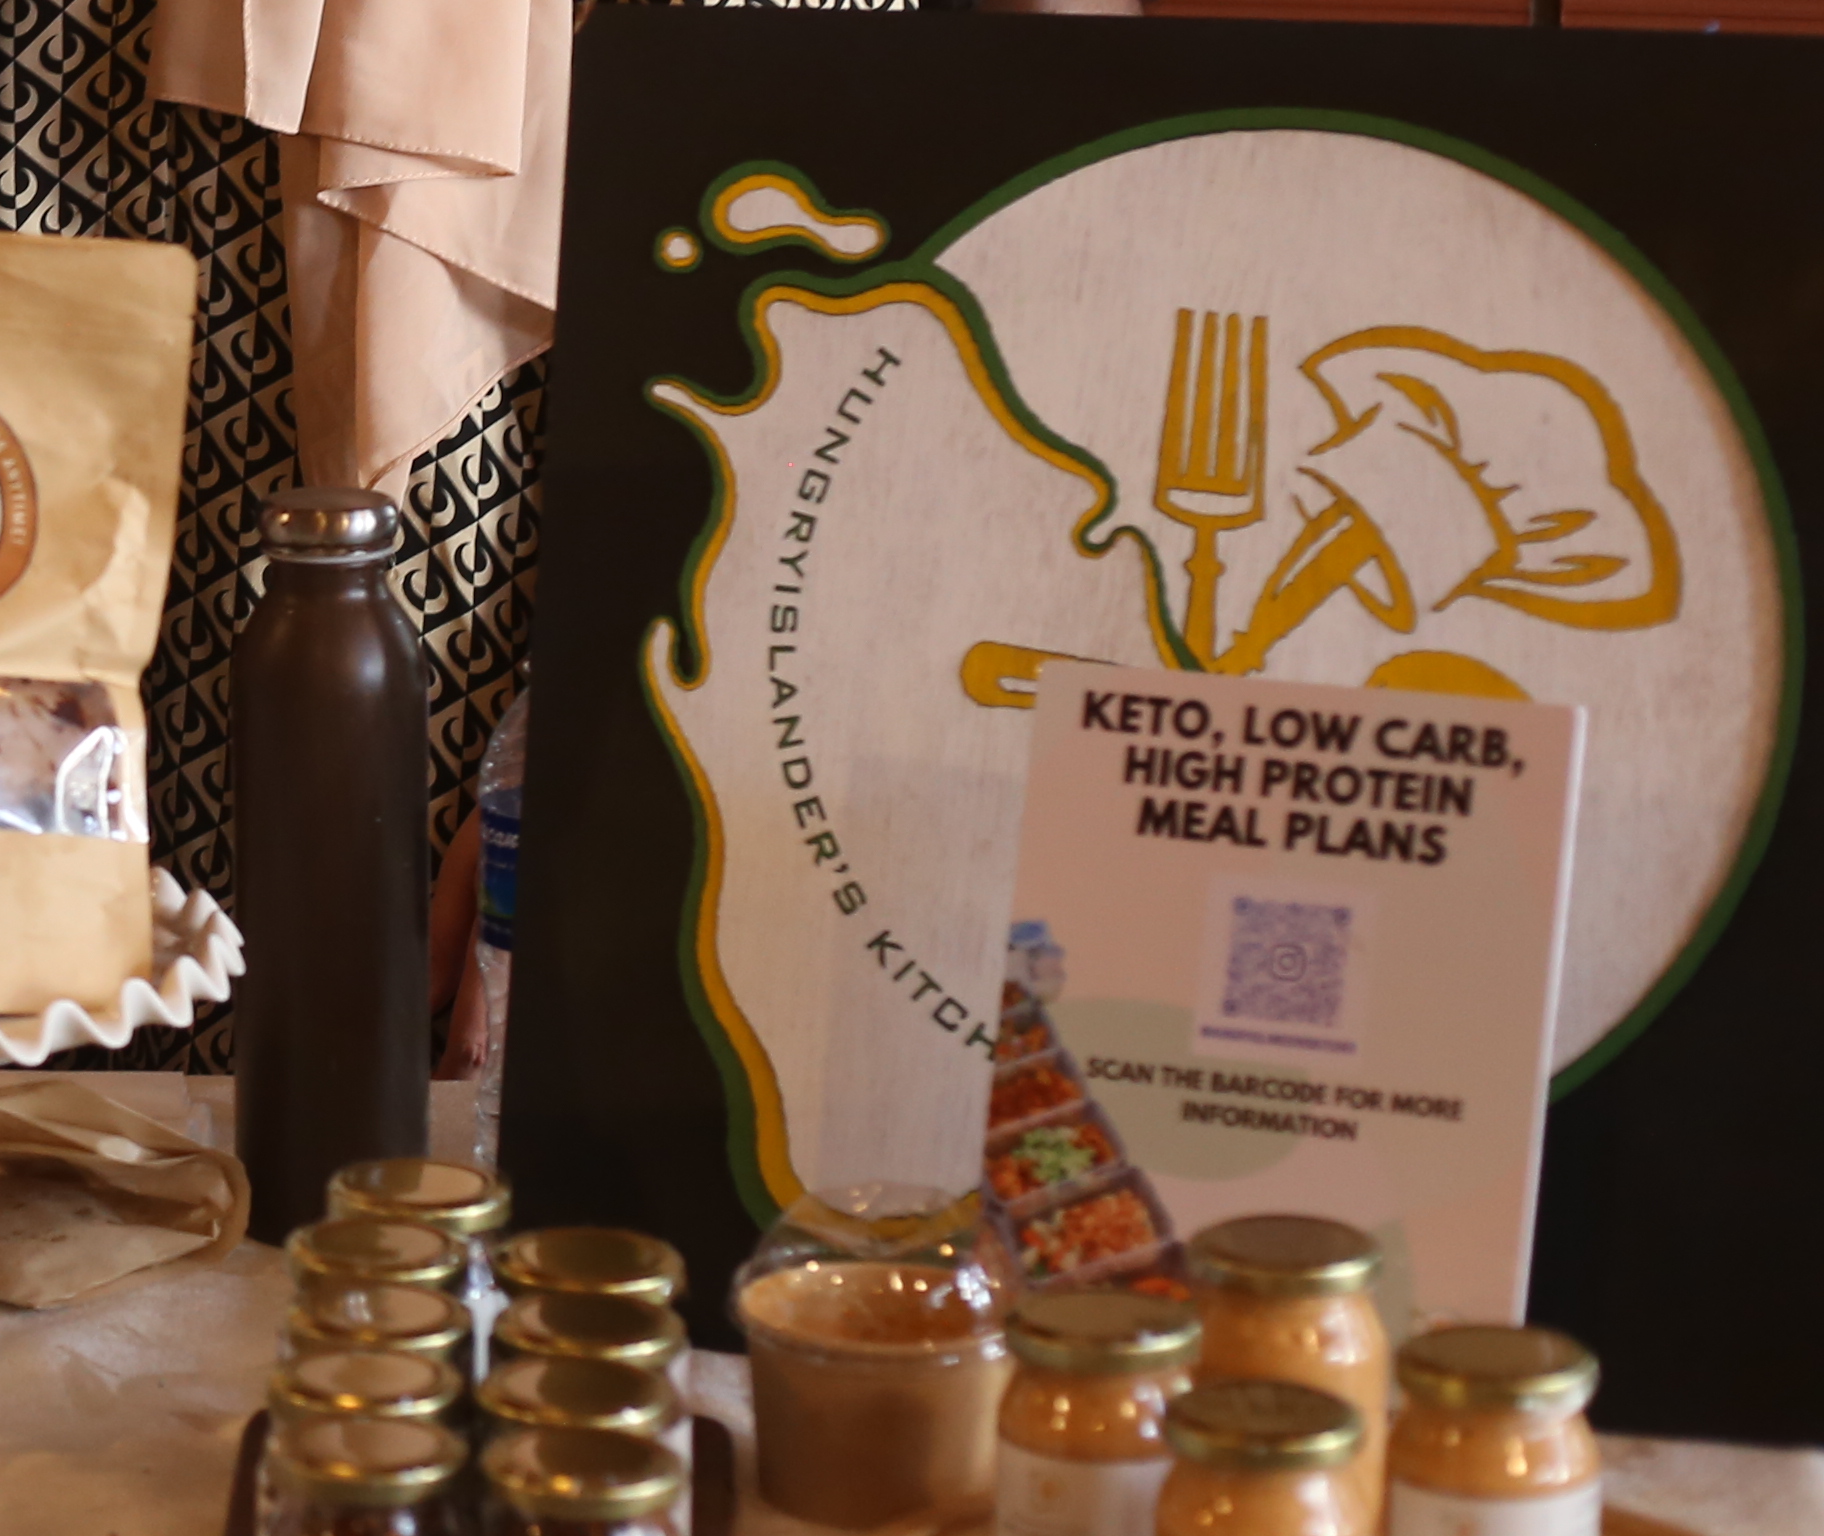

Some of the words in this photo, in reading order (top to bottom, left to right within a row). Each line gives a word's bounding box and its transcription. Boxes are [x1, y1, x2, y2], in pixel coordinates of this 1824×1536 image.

[767, 347, 902, 917] HUNGRYISLANDER'S
[867, 930, 1000, 1064] KITCH
[1082, 690, 1225, 746] KETO,
[1243, 705, 1362, 753] LOW
[1375, 719, 1526, 777] CARB,
[1123, 745, 1245, 794] HIGH
[1260, 759, 1474, 817] PROTEIN
[1136, 798, 1267, 848] MEAL
[1284, 812, 1448, 867] PLANS
[1087, 1057, 1155, 1086] SCAN
[1162, 1064, 1204, 1090] THE
[1210, 1071, 1327, 1106] BARCODE
[1335, 1086, 1385, 1110] FOR
[1391, 1092, 1463, 1121] MORE
[1181, 1101, 1359, 1142] INFORMATION
